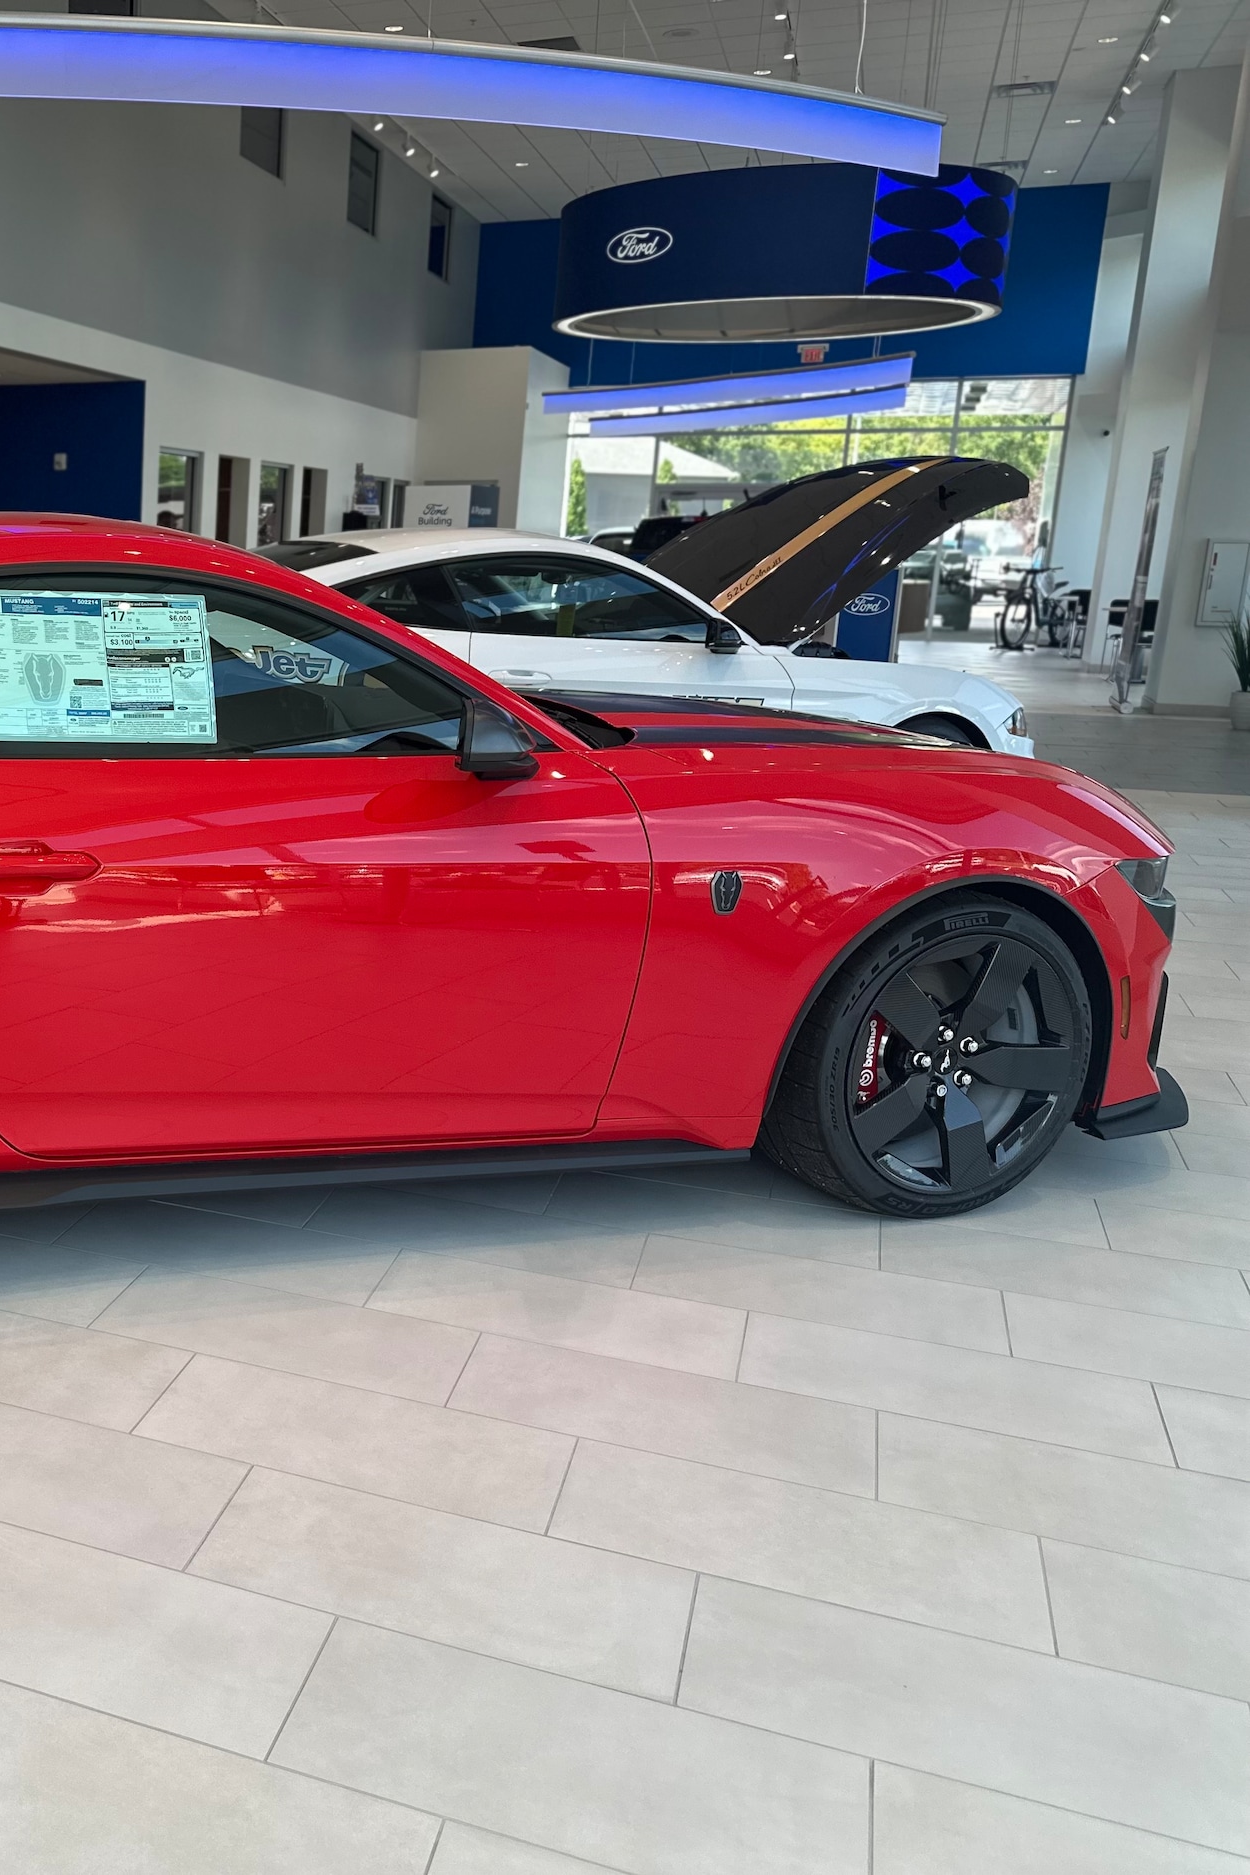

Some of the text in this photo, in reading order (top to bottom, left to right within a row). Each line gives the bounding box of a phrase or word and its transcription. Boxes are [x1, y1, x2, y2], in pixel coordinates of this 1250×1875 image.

[617, 232, 660, 259] Ford
[423, 503, 449, 516] Ford
[418, 517, 452, 527] Building
[851, 595, 881, 612] Ford
[110, 610, 125, 622] 17
[252, 645, 332, 683] Jet
[944, 912, 989, 931] PIRELLI
[862, 1019, 878, 1068] brembo
[887, 1196, 912, 1211] RS
